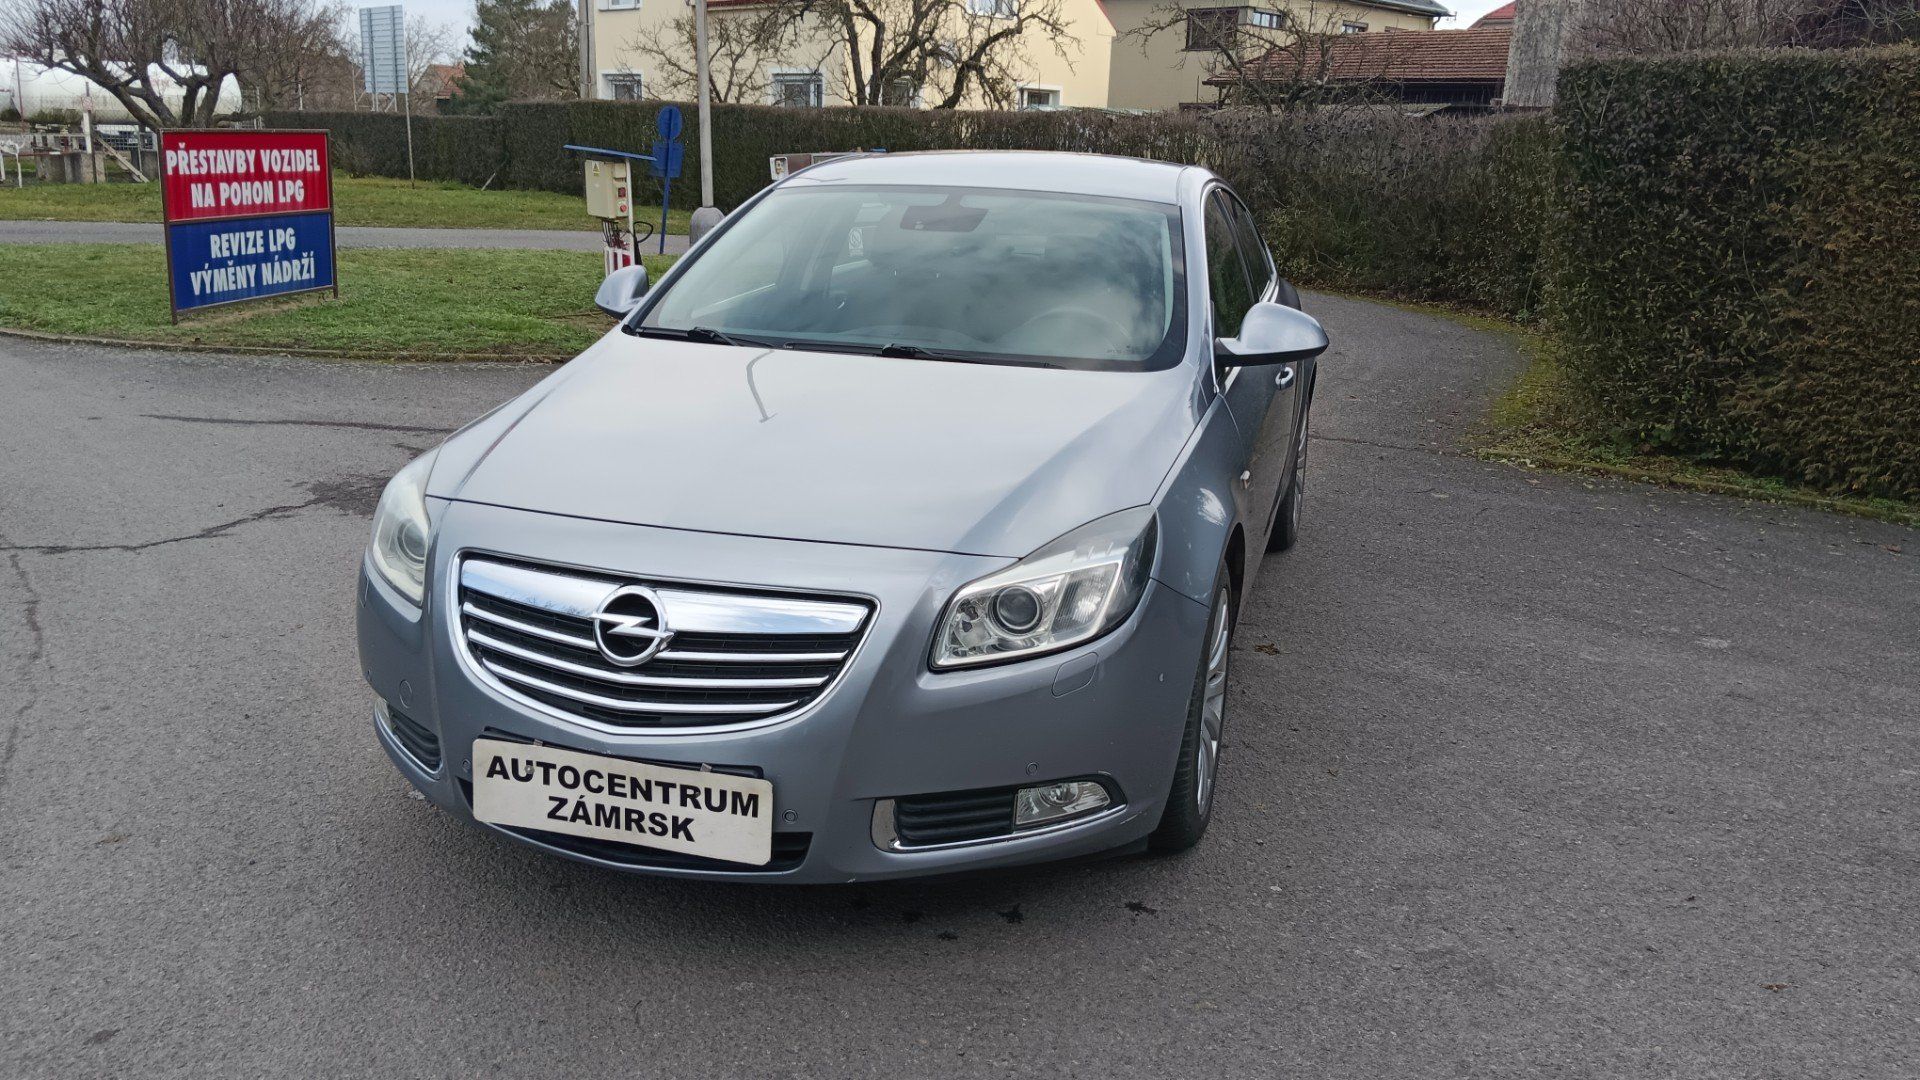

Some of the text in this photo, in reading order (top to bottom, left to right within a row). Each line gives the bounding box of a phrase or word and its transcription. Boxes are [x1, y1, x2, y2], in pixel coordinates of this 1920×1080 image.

[166, 142, 320, 175] PŘESTAVBY VOZIDEL
[191, 179, 305, 208] NA POHON LPG
[210, 227, 296, 259] REVIZE LPG
[190, 251, 315, 296] VÝMĚNY NÁDRŽÍ
[486, 755, 759, 818] AUTOCENTRUM
[547, 794, 697, 842] ZÁMRSK
